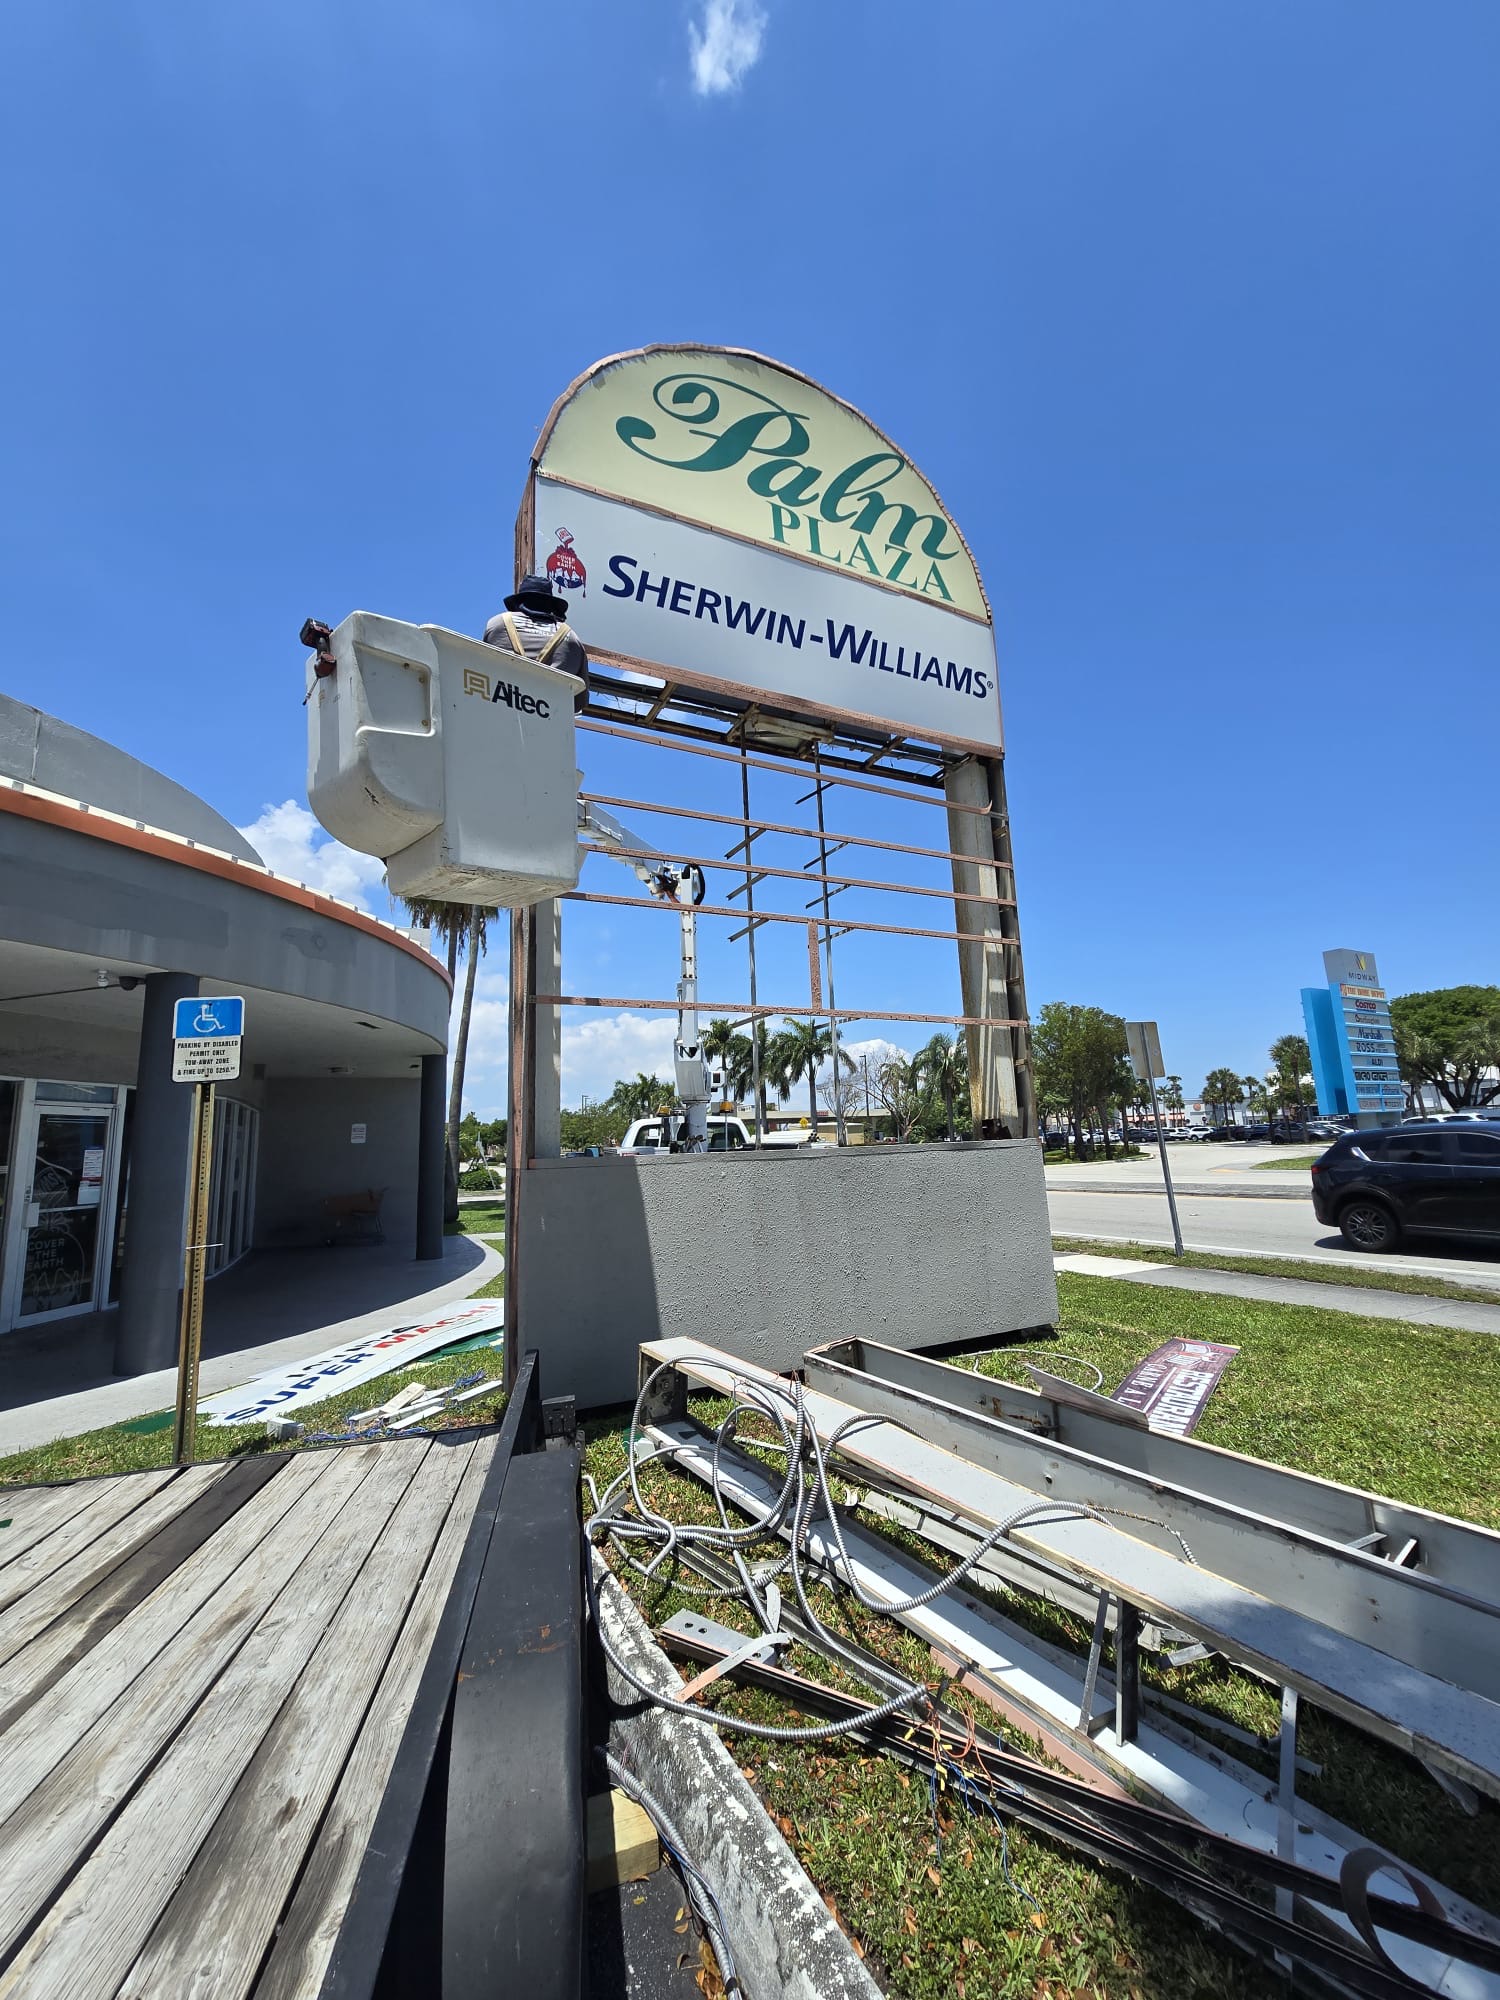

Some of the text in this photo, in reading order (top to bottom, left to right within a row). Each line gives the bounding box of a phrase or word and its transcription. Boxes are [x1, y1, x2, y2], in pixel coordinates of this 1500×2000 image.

[616, 373, 959, 560] Palm
[766, 500, 956, 603] PLAZA
[491, 680, 550, 719] Altec
[1348, 971, 1376, 981] MIDWAY
[1356, 1042, 1375, 1052] ROSS
[185, 1058, 213, 1066] TOW-AWAY
[28, 1238, 65, 1251] COVER
[35, 1248, 57, 1260] THE
[26, 1257, 64, 1271] EARTH
[224, 1352, 376, 1421] SUPER
